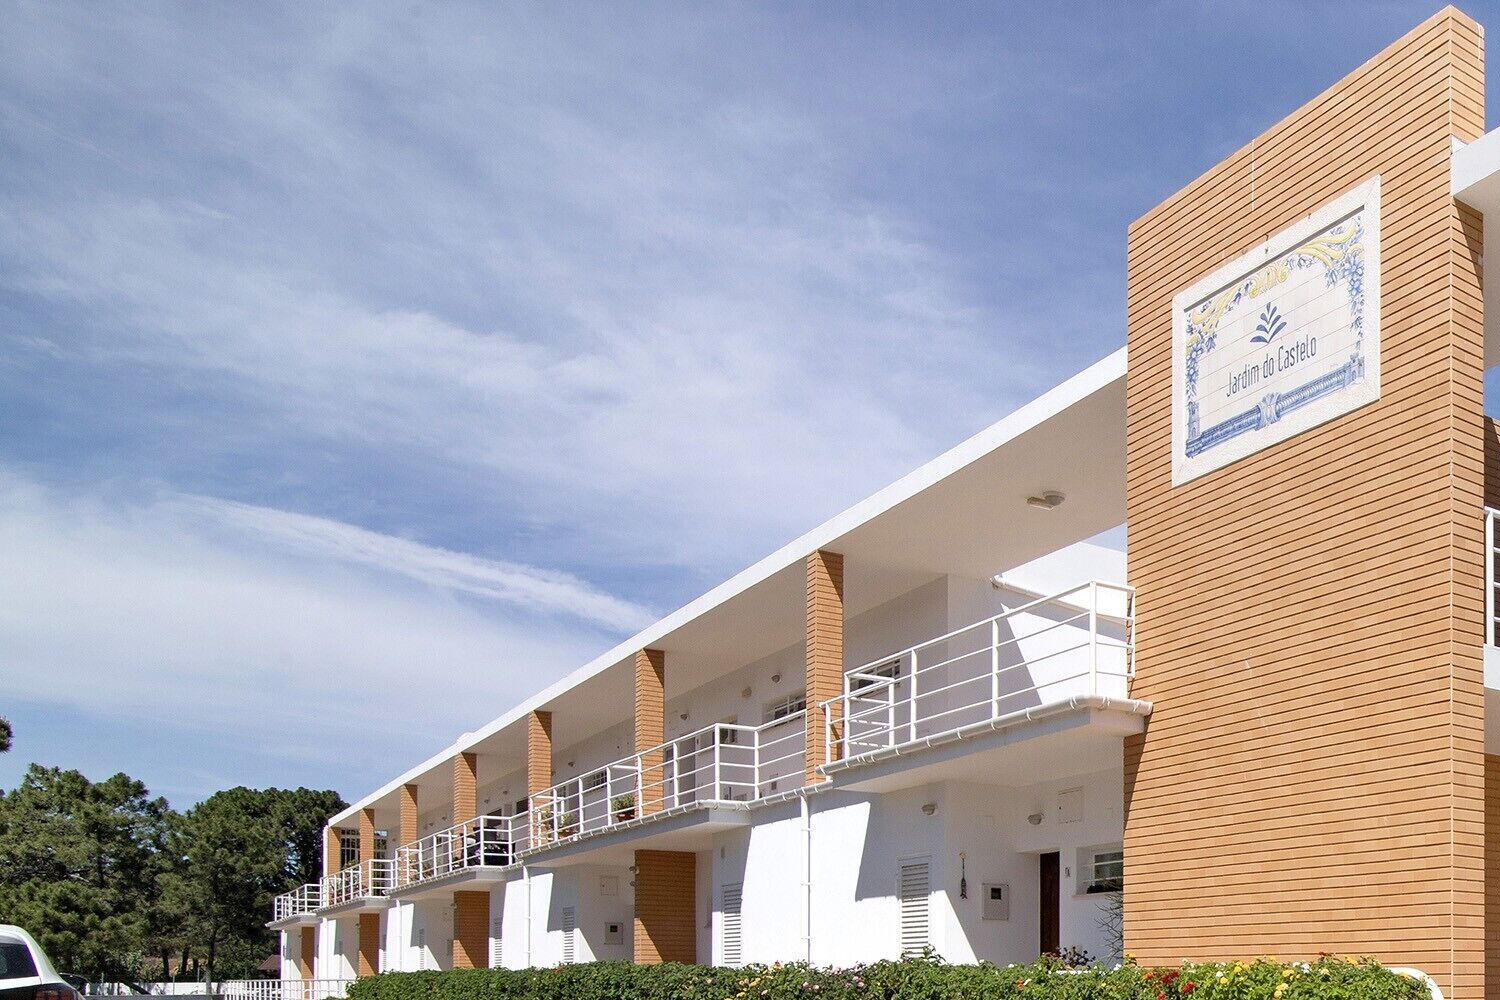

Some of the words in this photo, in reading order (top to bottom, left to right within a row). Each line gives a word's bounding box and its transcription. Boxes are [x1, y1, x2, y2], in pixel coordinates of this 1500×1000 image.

[1226, 364, 1260, 397] Jardim
[1262, 353, 1275, 379] do
[1278, 334, 1317, 372] Castelo
